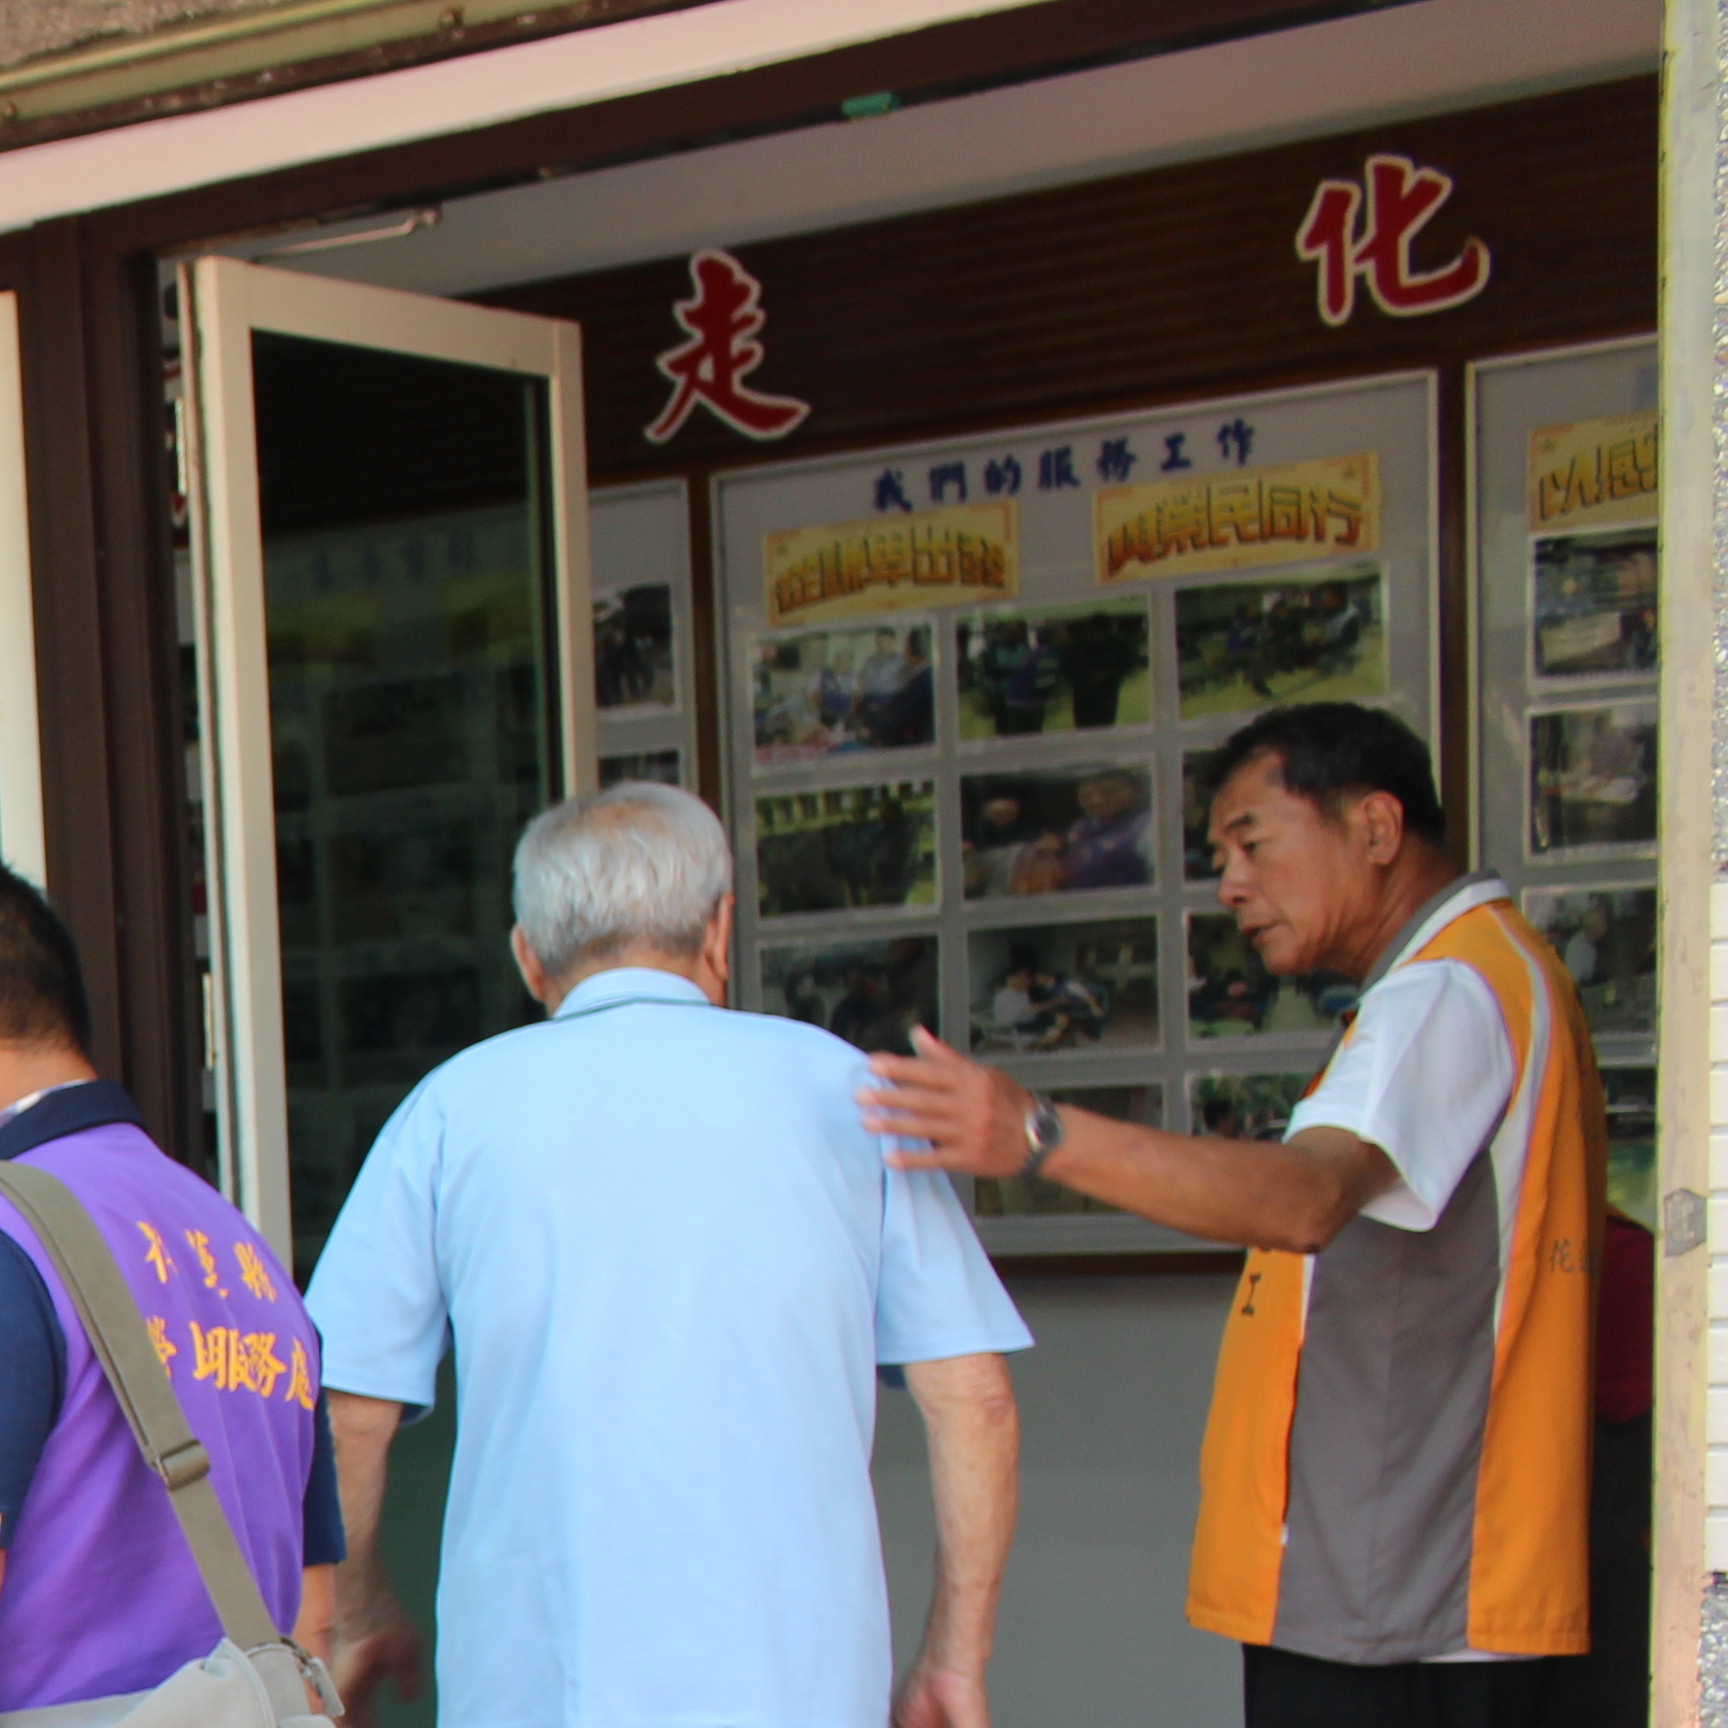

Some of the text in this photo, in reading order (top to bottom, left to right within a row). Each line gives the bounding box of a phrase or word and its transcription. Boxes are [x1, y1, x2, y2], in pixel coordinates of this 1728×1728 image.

[645, 154, 1490, 445] 走 化
[872, 417, 1256, 513] 我們的服務工作
